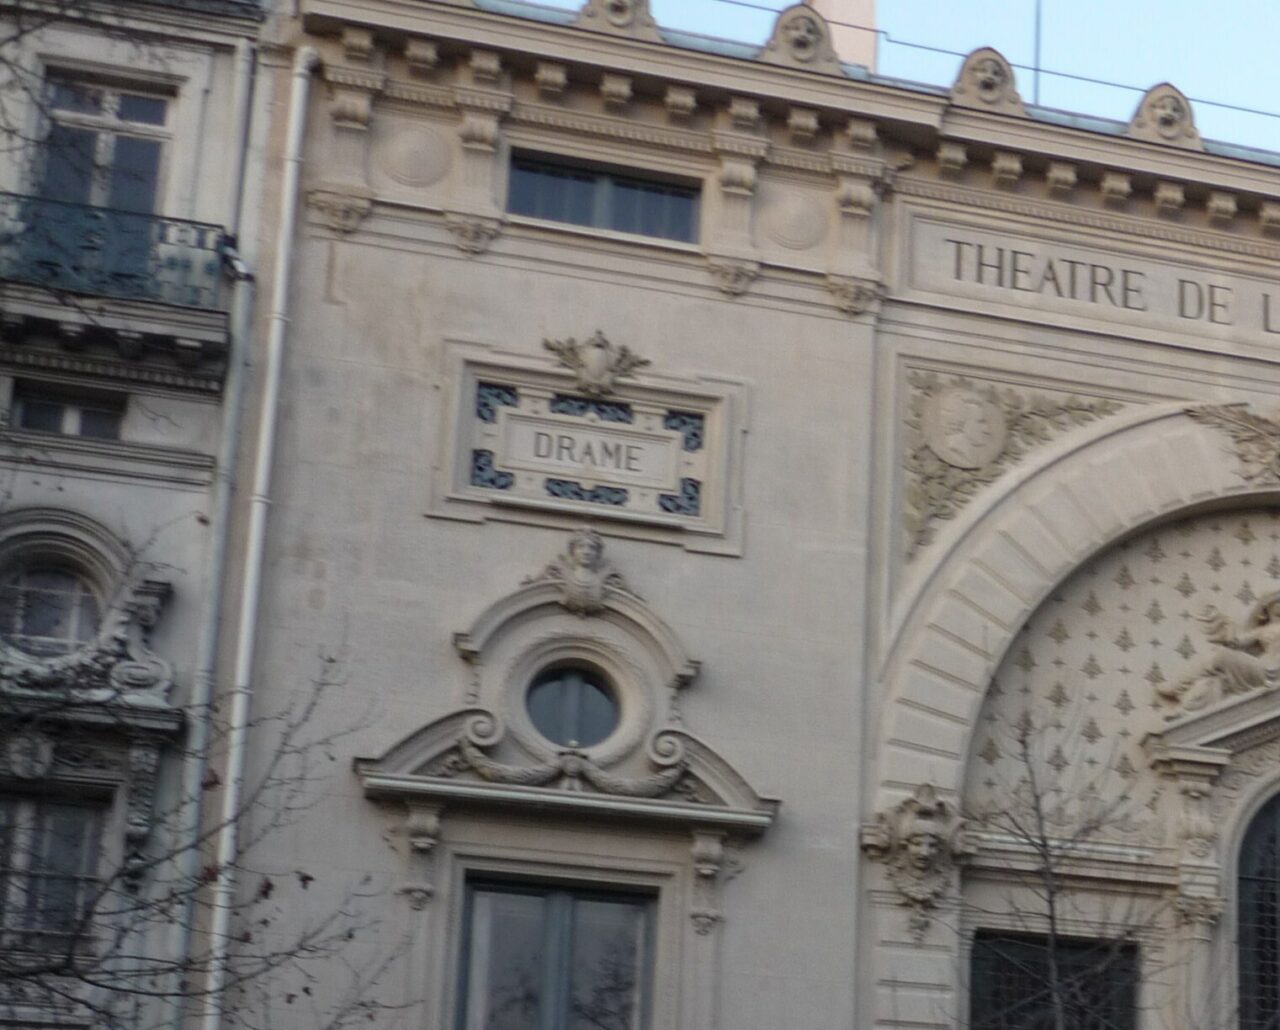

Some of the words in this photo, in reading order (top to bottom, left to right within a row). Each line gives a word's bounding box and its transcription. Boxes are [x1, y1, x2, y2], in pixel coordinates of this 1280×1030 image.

[945, 238, 1148, 312] THEATRE
[1177, 278, 1233, 326] DE
[532, 431, 644, 472] DRAME
